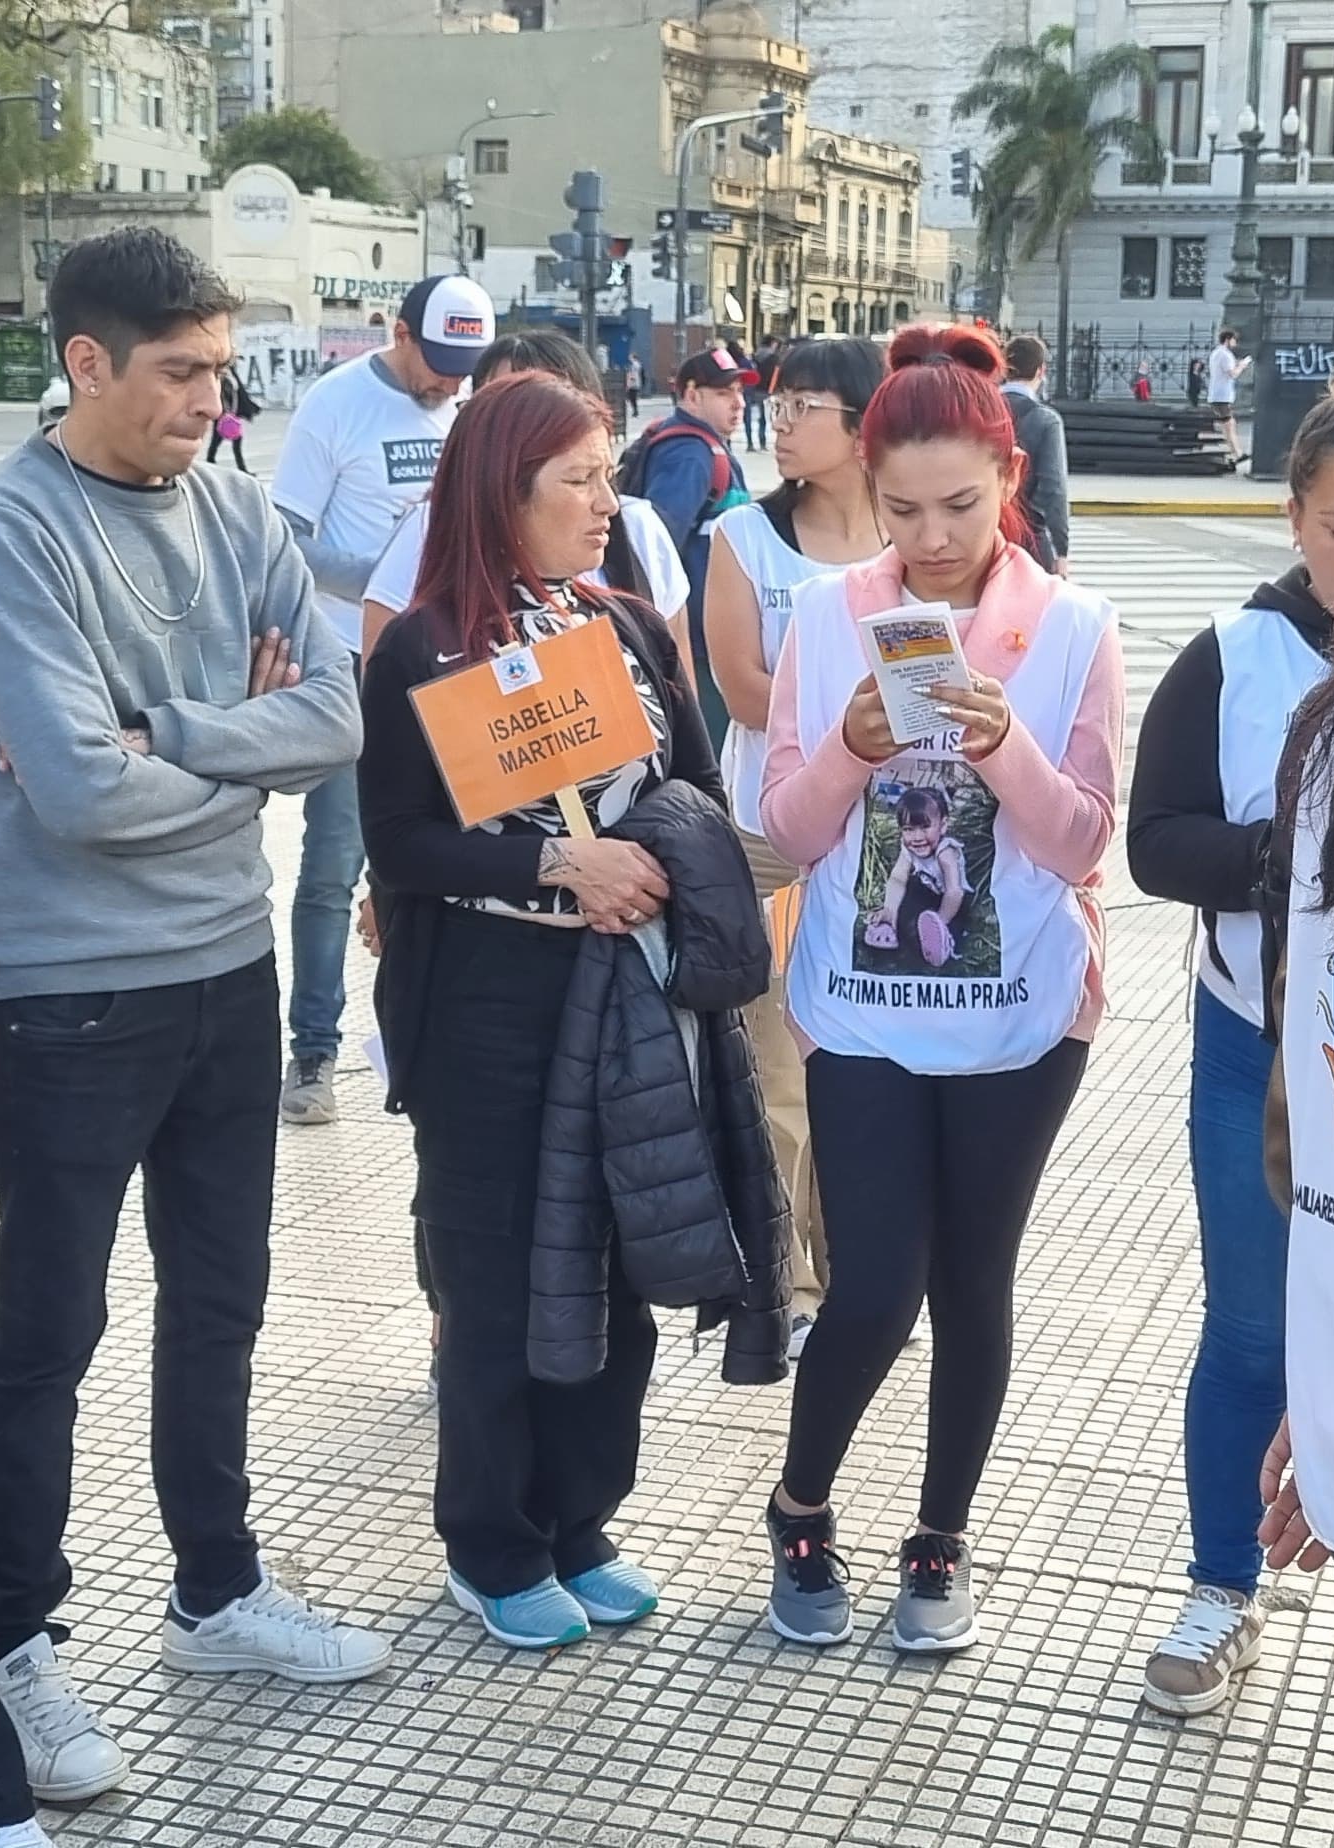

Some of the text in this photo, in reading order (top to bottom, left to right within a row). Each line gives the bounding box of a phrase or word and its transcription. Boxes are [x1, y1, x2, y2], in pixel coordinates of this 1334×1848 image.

[313, 275, 338, 297] DI
[389, 442, 443, 461] JUSTIC
[487, 688, 590, 743] ISABELLA
[497, 716, 603, 775] MARTINEZ
[892, 982, 913, 1008] DE
[917, 982, 967, 1009] MALA
[971, 976, 1029, 1009] PRAXIS
